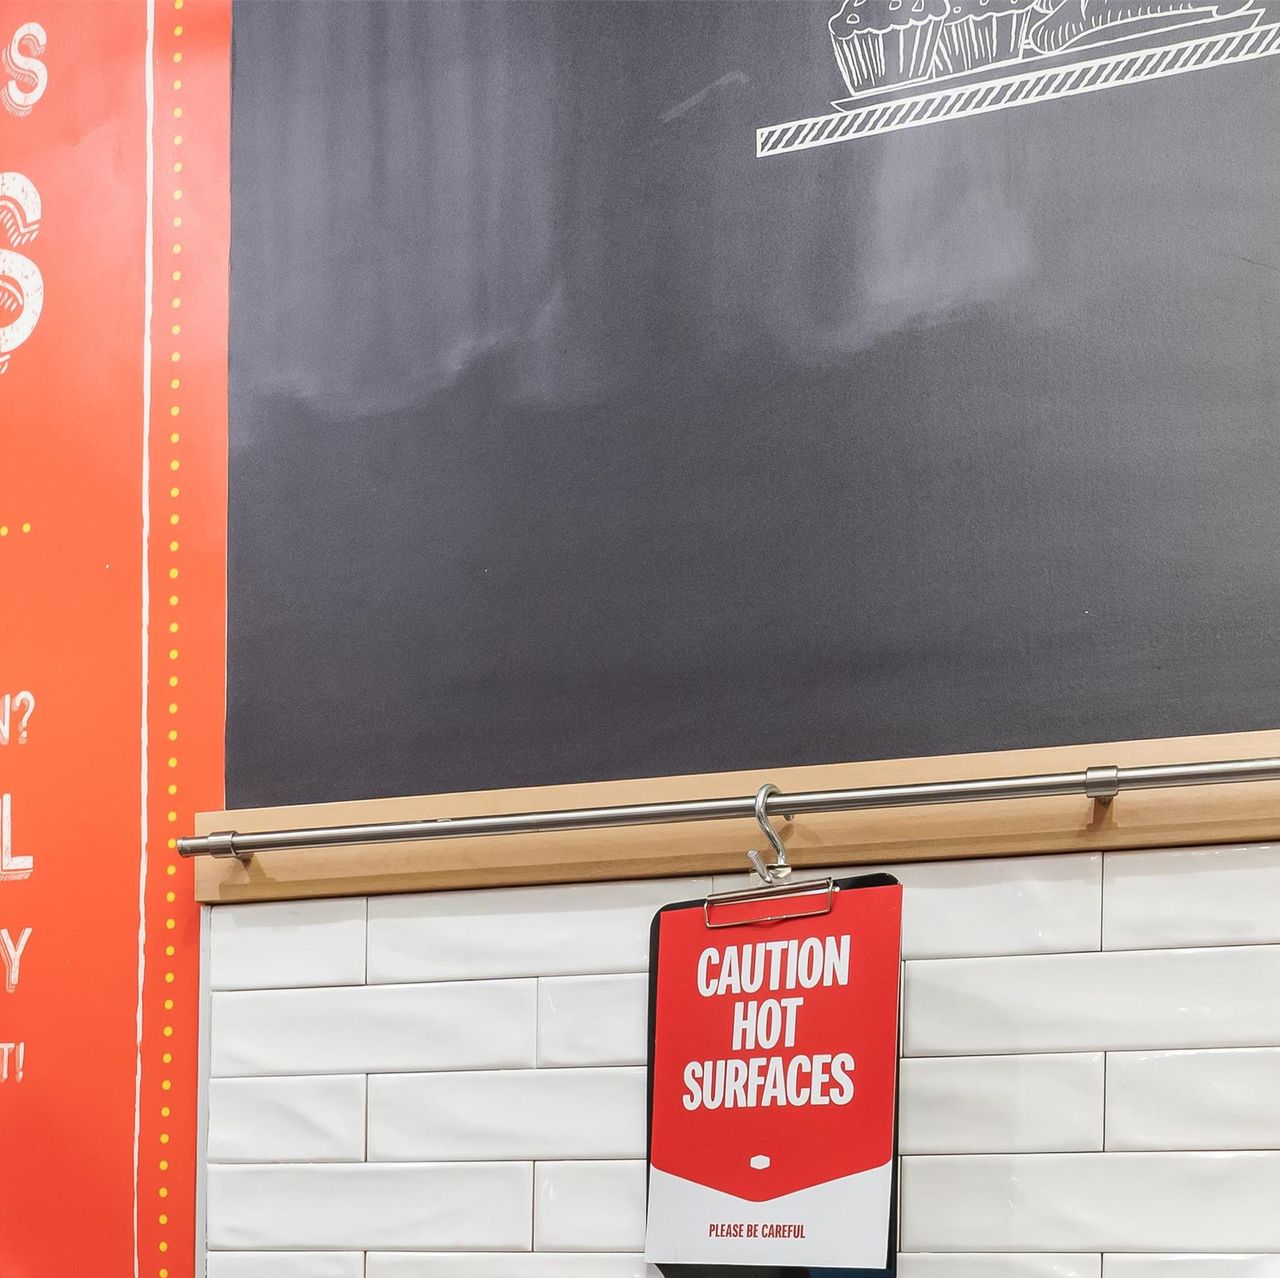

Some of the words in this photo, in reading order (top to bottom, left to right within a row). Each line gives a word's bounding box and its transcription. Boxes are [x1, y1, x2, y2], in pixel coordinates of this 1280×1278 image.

[697, 935, 851, 997] CAUTION
[732, 997, 804, 1050] HOT
[682, 1053, 855, 1111] SURFACES
[708, 1223, 744, 1239] PLEASE
[746, 1223, 758, 1239] BE
[761, 1223, 806, 1239] CAREFUL
